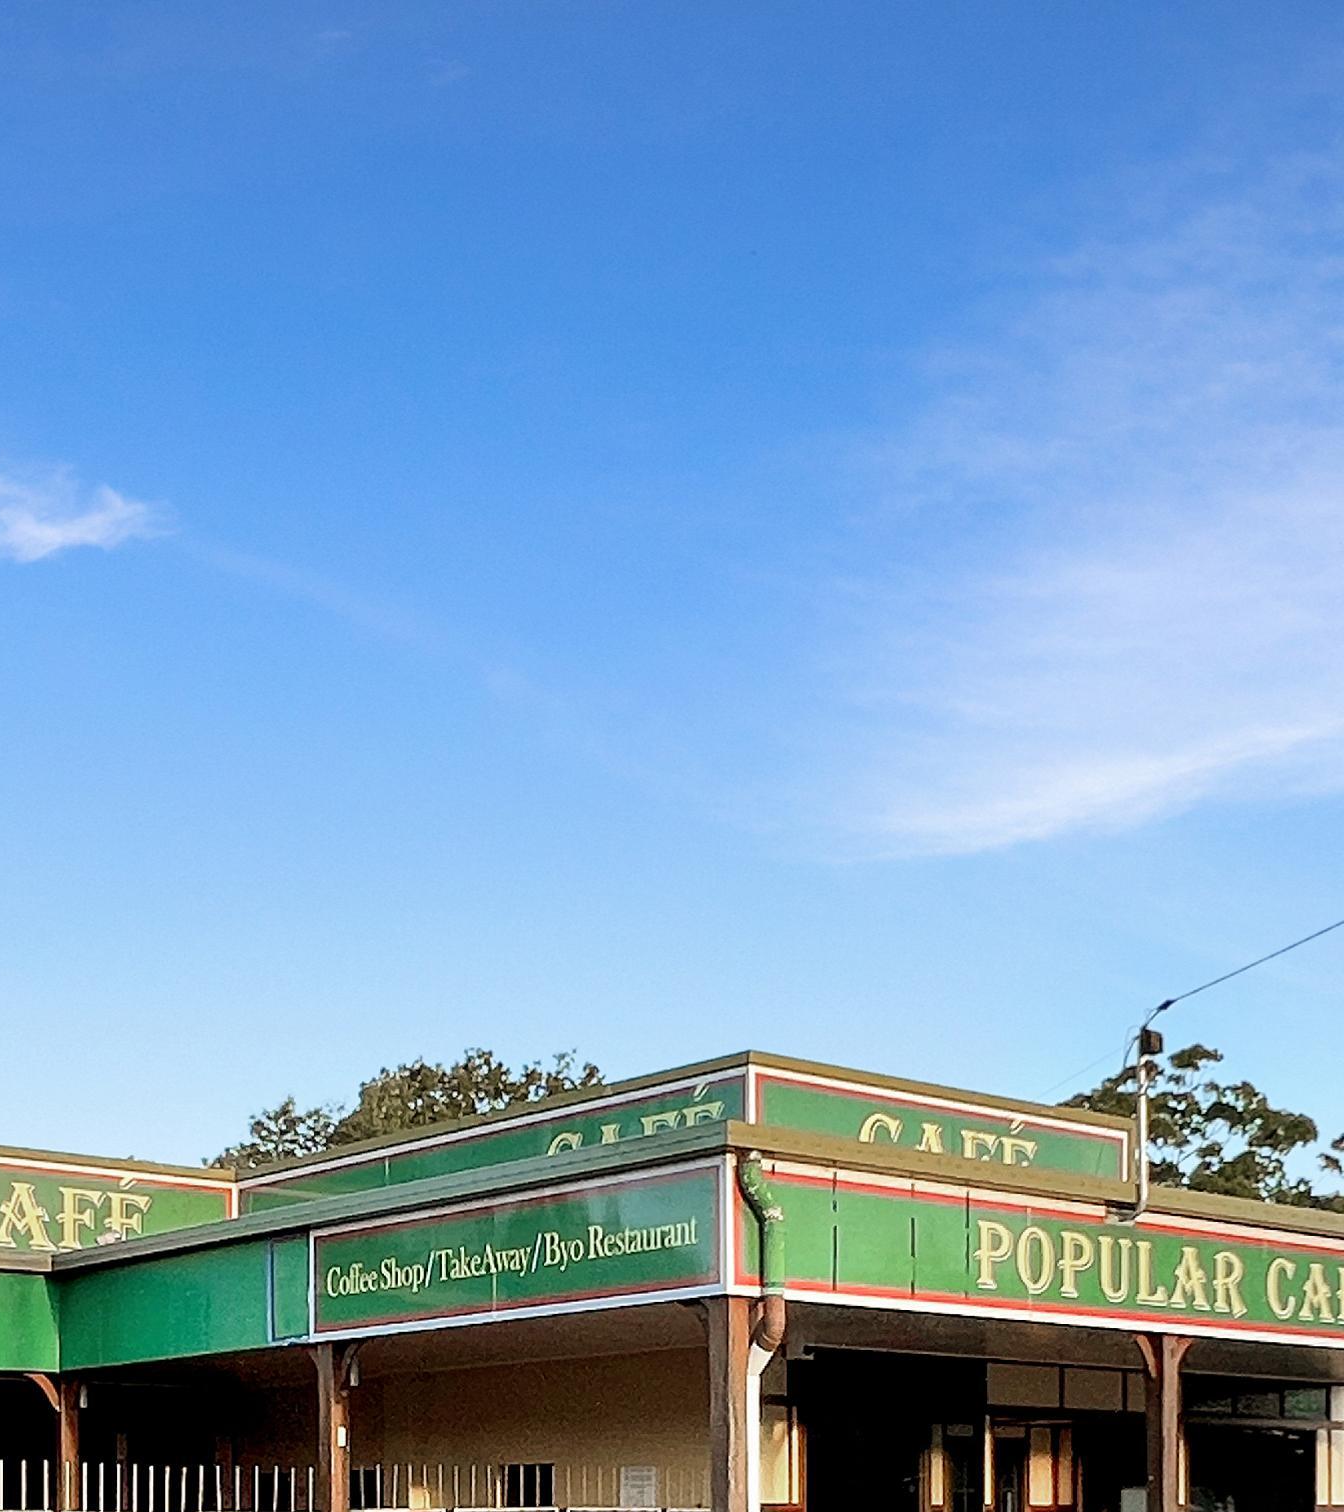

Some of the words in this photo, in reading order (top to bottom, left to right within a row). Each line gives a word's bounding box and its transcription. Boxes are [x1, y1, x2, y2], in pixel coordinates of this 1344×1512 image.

[326, 1260, 378, 1299] Coffee
[587, 1216, 698, 1260] Restaurant
[973, 1219, 1248, 1319] POPULAR
